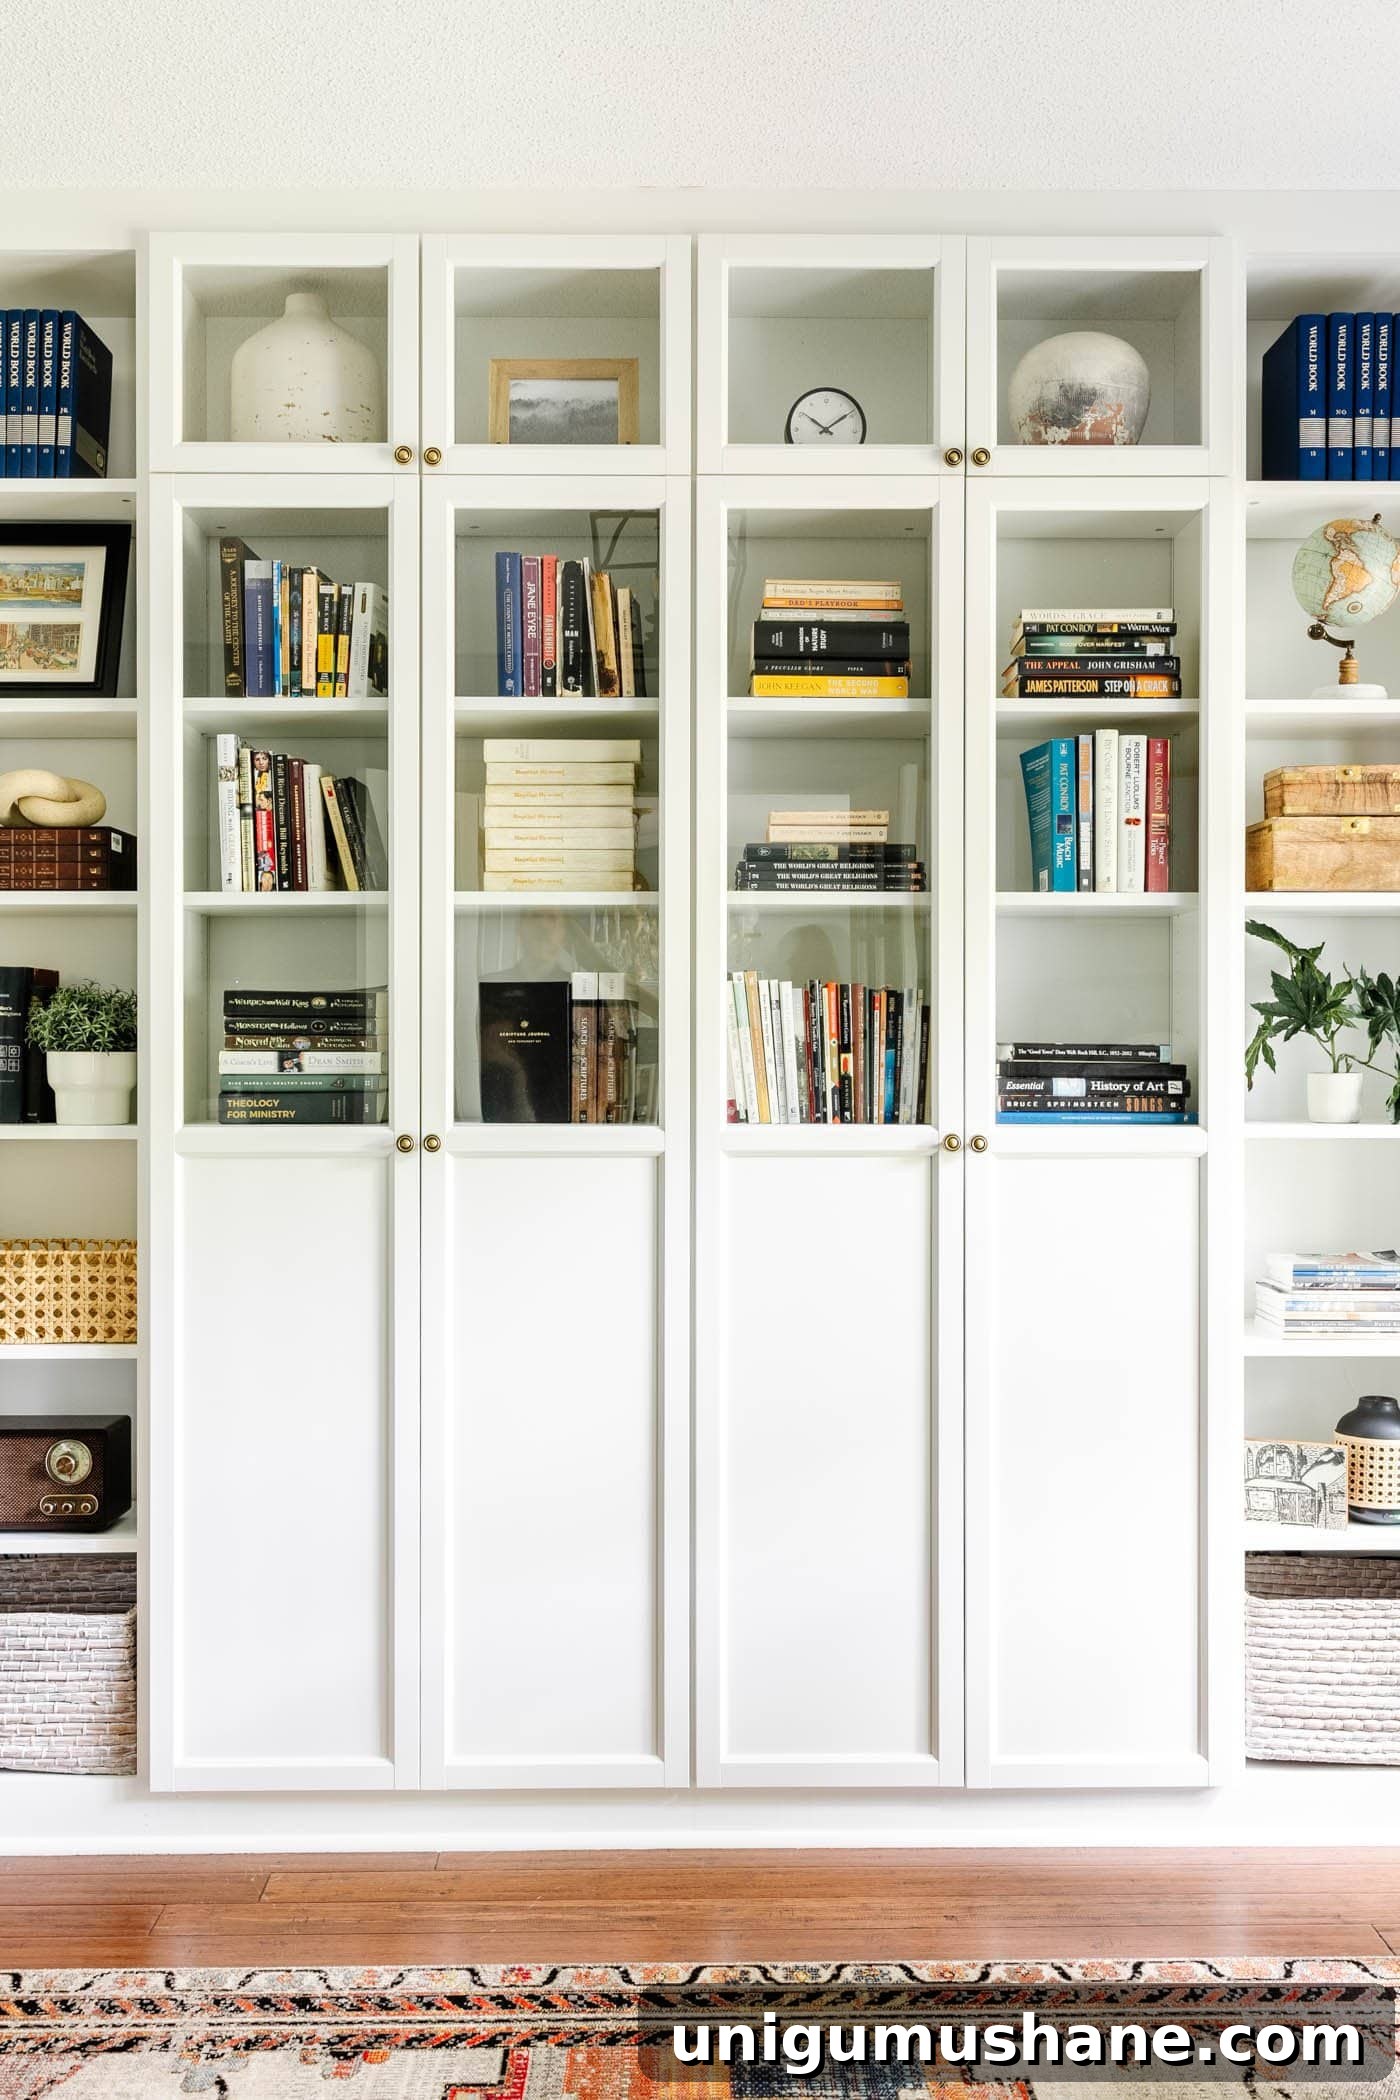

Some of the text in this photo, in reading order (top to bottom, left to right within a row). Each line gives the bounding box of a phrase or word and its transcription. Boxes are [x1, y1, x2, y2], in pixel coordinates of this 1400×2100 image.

[10, 321, 20, 388] WORLD BOOK
[26, 321, 36, 388] WORLD BOOK
[43, 321, 53, 388] WORLD BOOK
[61, 322, 72, 388] WORLD BOOK
[1308, 326, 1318, 392] WORLD BOOK
[1336, 324, 1346, 391] WORLD BOOK
[1361, 324, 1370, 390] WORLD BOOK
[1378, 324, 1388, 391] WORLD BOOK
[224, 592, 230, 603] OF
[232, 610, 238, 621] TO
[527, 582, 536, 638] JANE EYRE
[544, 614, 554, 656] FAHRENHEIT
[1046, 624, 1094, 632] PAT CONROY
[759, 682, 822, 690] JOHN KEEGAN
[1025, 680, 1098, 693] JAMES PATTERSON
[1104, 681, 1168, 692] STEP ON A CRACK
[1060, 763, 1068, 811] PAT CONROY
[1154, 762, 1163, 811] PAT CONROY
[280, 842, 288, 874] Reynolds
[1006, 1081, 1044, 1090] Essential
[1090, 1081, 1164, 1092] History of Art
[1126, 1098, 1163, 1112] SONGS
[227, 1110, 296, 1118] FOR MINISTRY
